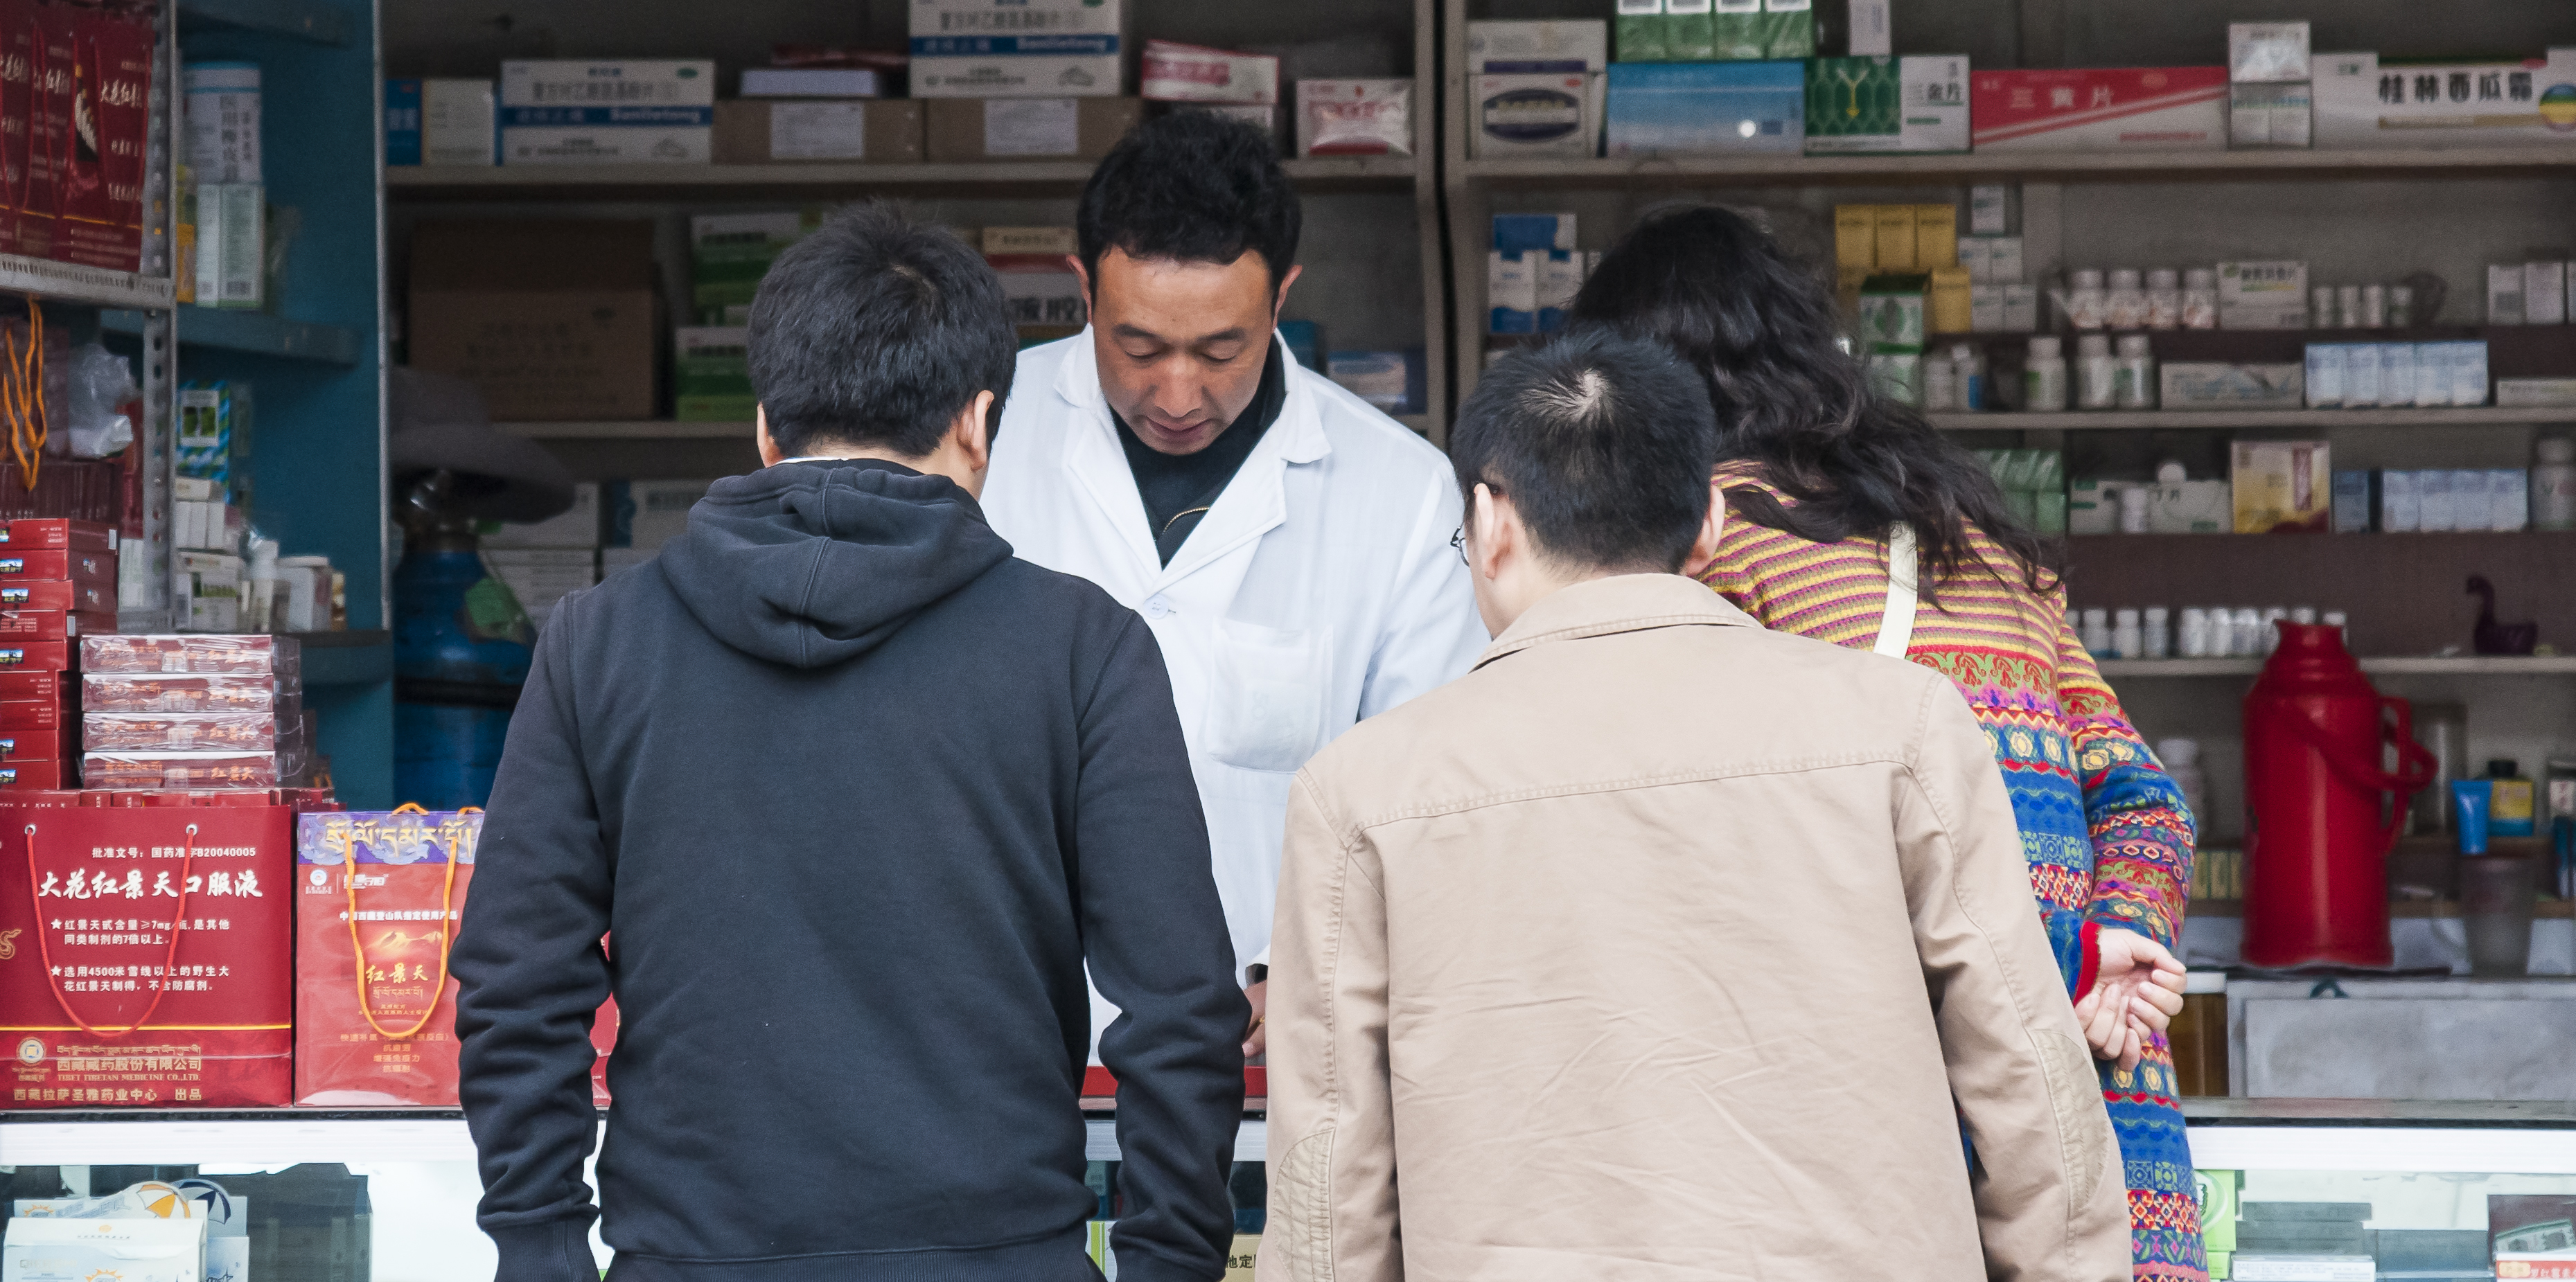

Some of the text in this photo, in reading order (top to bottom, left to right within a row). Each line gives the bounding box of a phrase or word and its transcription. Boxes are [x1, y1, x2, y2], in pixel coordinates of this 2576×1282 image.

[2009, 84, 2115, 109] 三黄片
[2379, 71, 2532, 103] 桂林西瓜霜
[38, 867, 263, 900] 大花红景天口服液
[365, 962, 428, 984] 红景天
[57, 1058, 202, 1071] 西藏藏药股份有限公司
[175, 1088, 202, 1101] 出品
